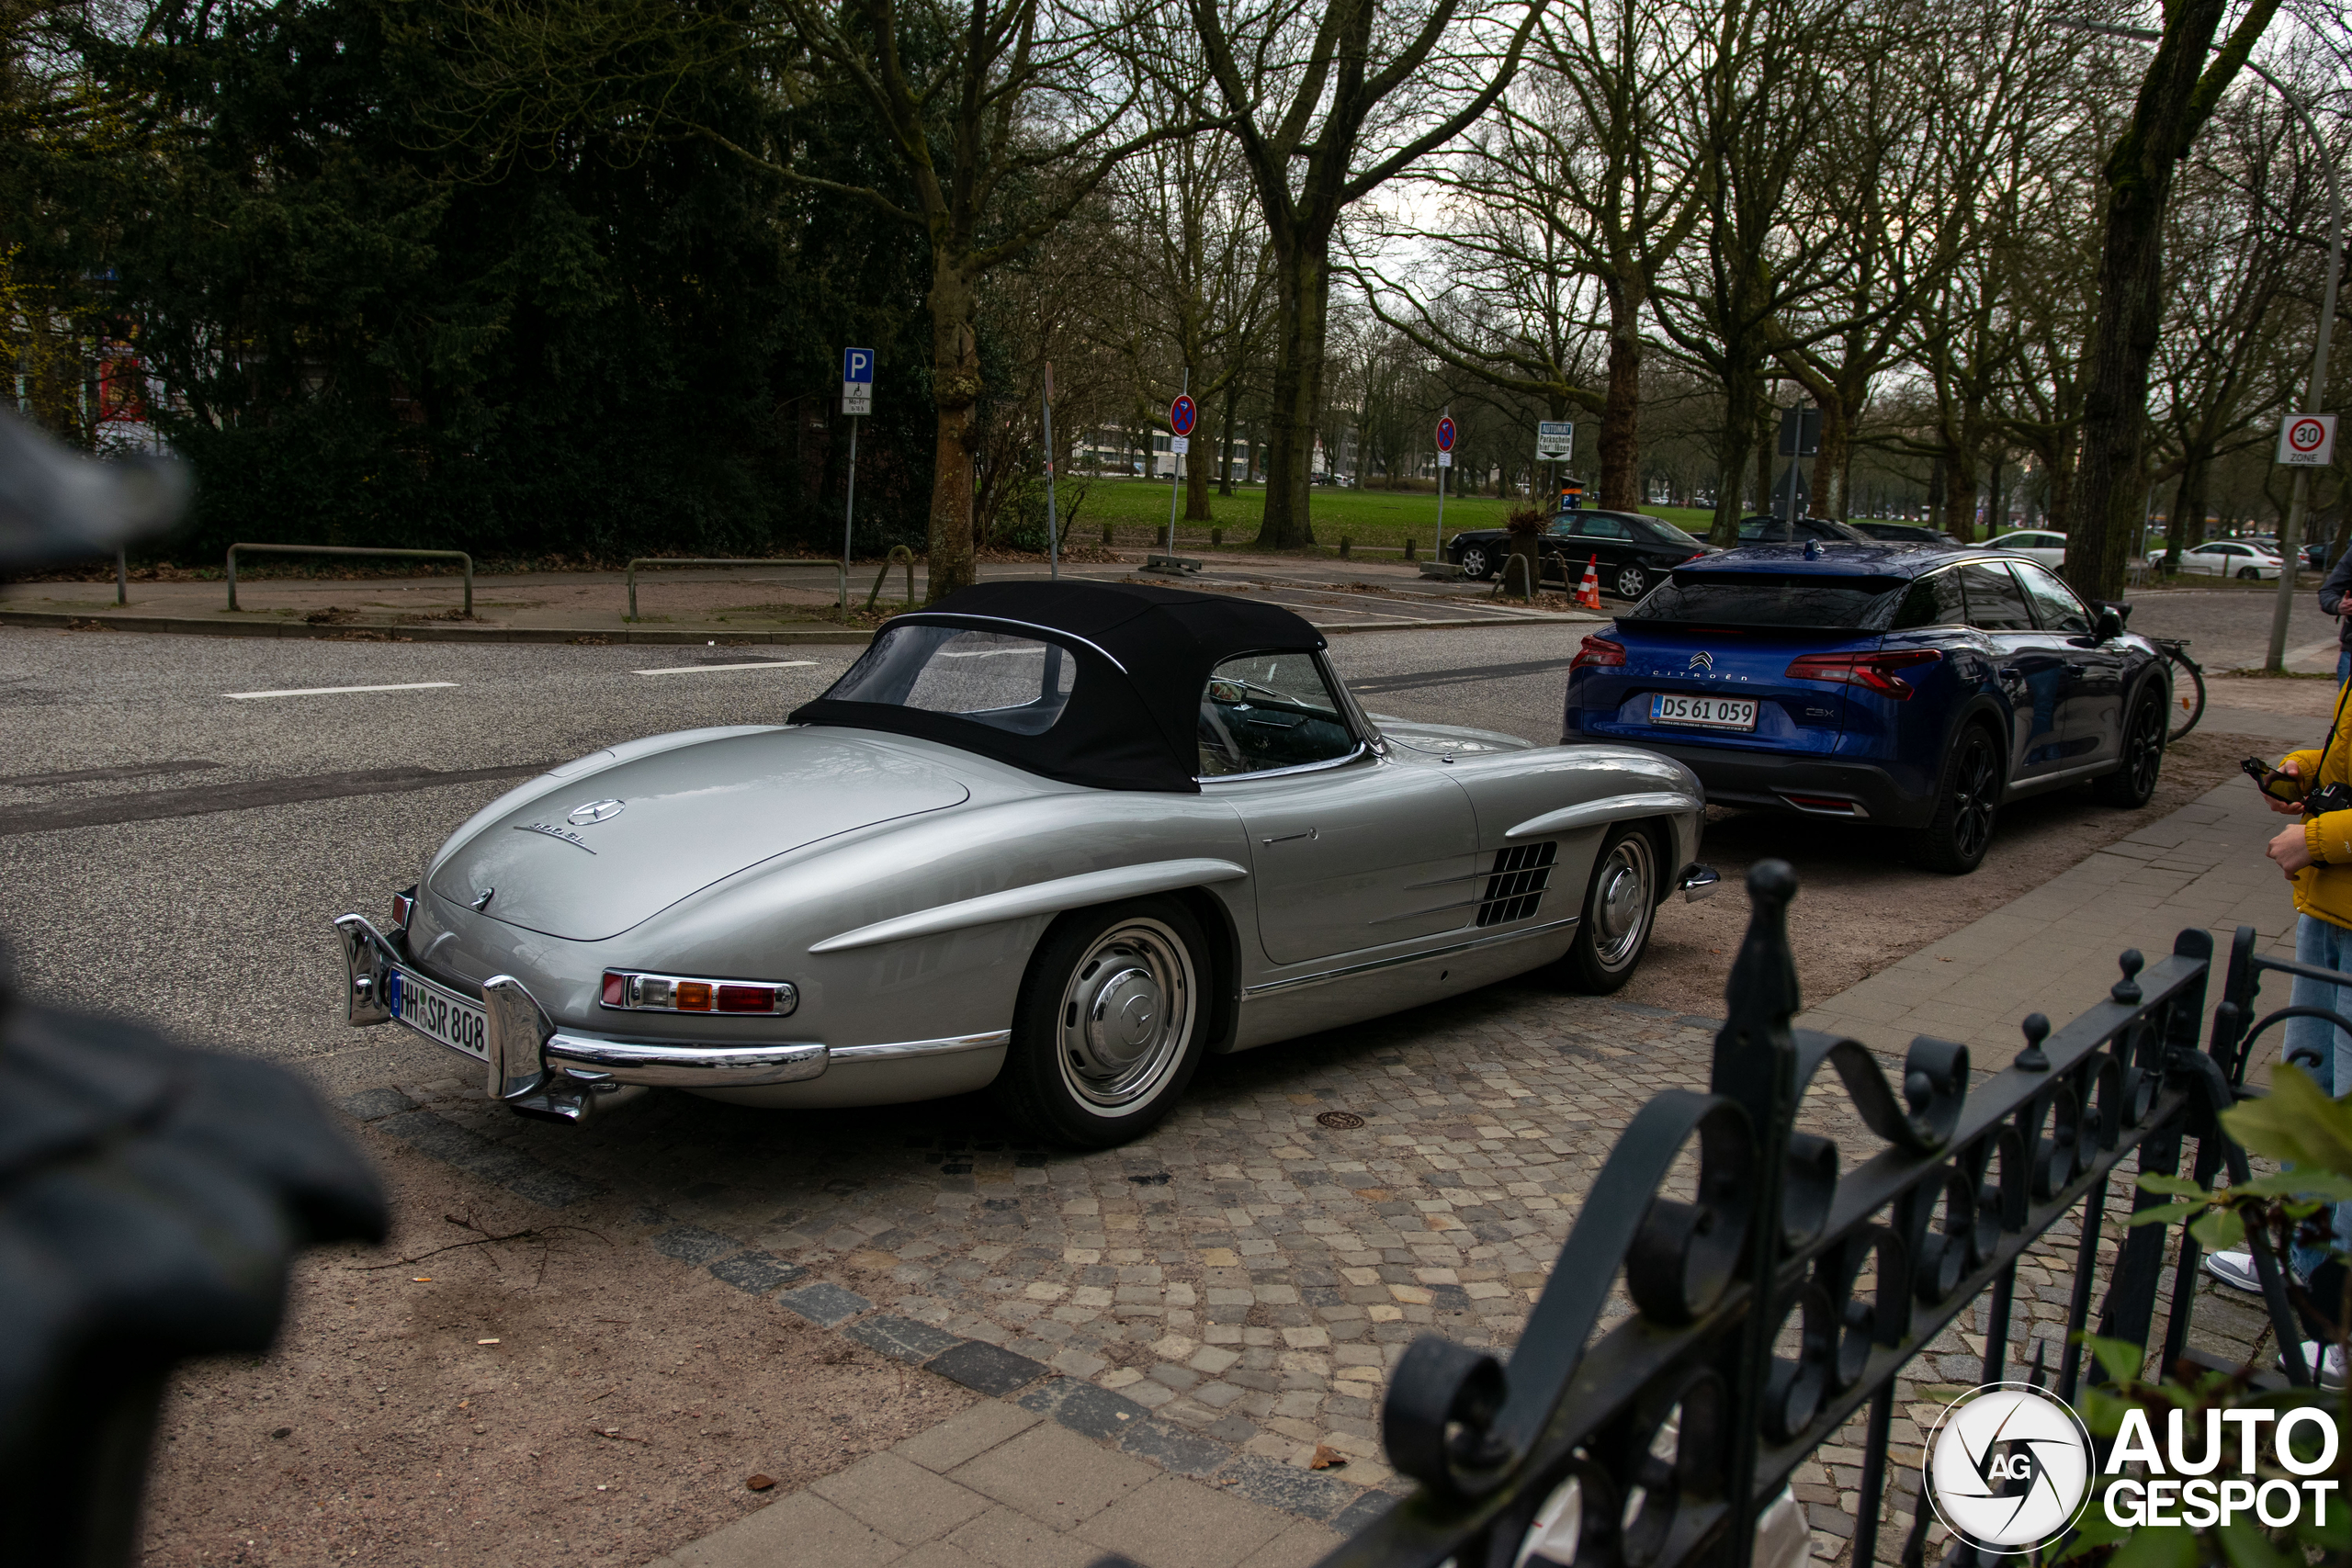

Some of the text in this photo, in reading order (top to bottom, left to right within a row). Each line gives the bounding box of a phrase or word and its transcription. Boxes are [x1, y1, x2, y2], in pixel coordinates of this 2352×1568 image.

[851, 353, 866, 378] P
[1542, 424, 1570, 434] AUTOMAT
[2297, 427, 2318, 443] 30
[1539, 435, 1570, 444] Parkschein
[1555, 444, 1569, 452] lösen
[2291, 454, 2318, 462] ZONE
[1663, 699, 1752, 722] DS 61 059
[529, 823, 585, 844] 300 SL
[401, 979, 484, 1053] HH SR 808
